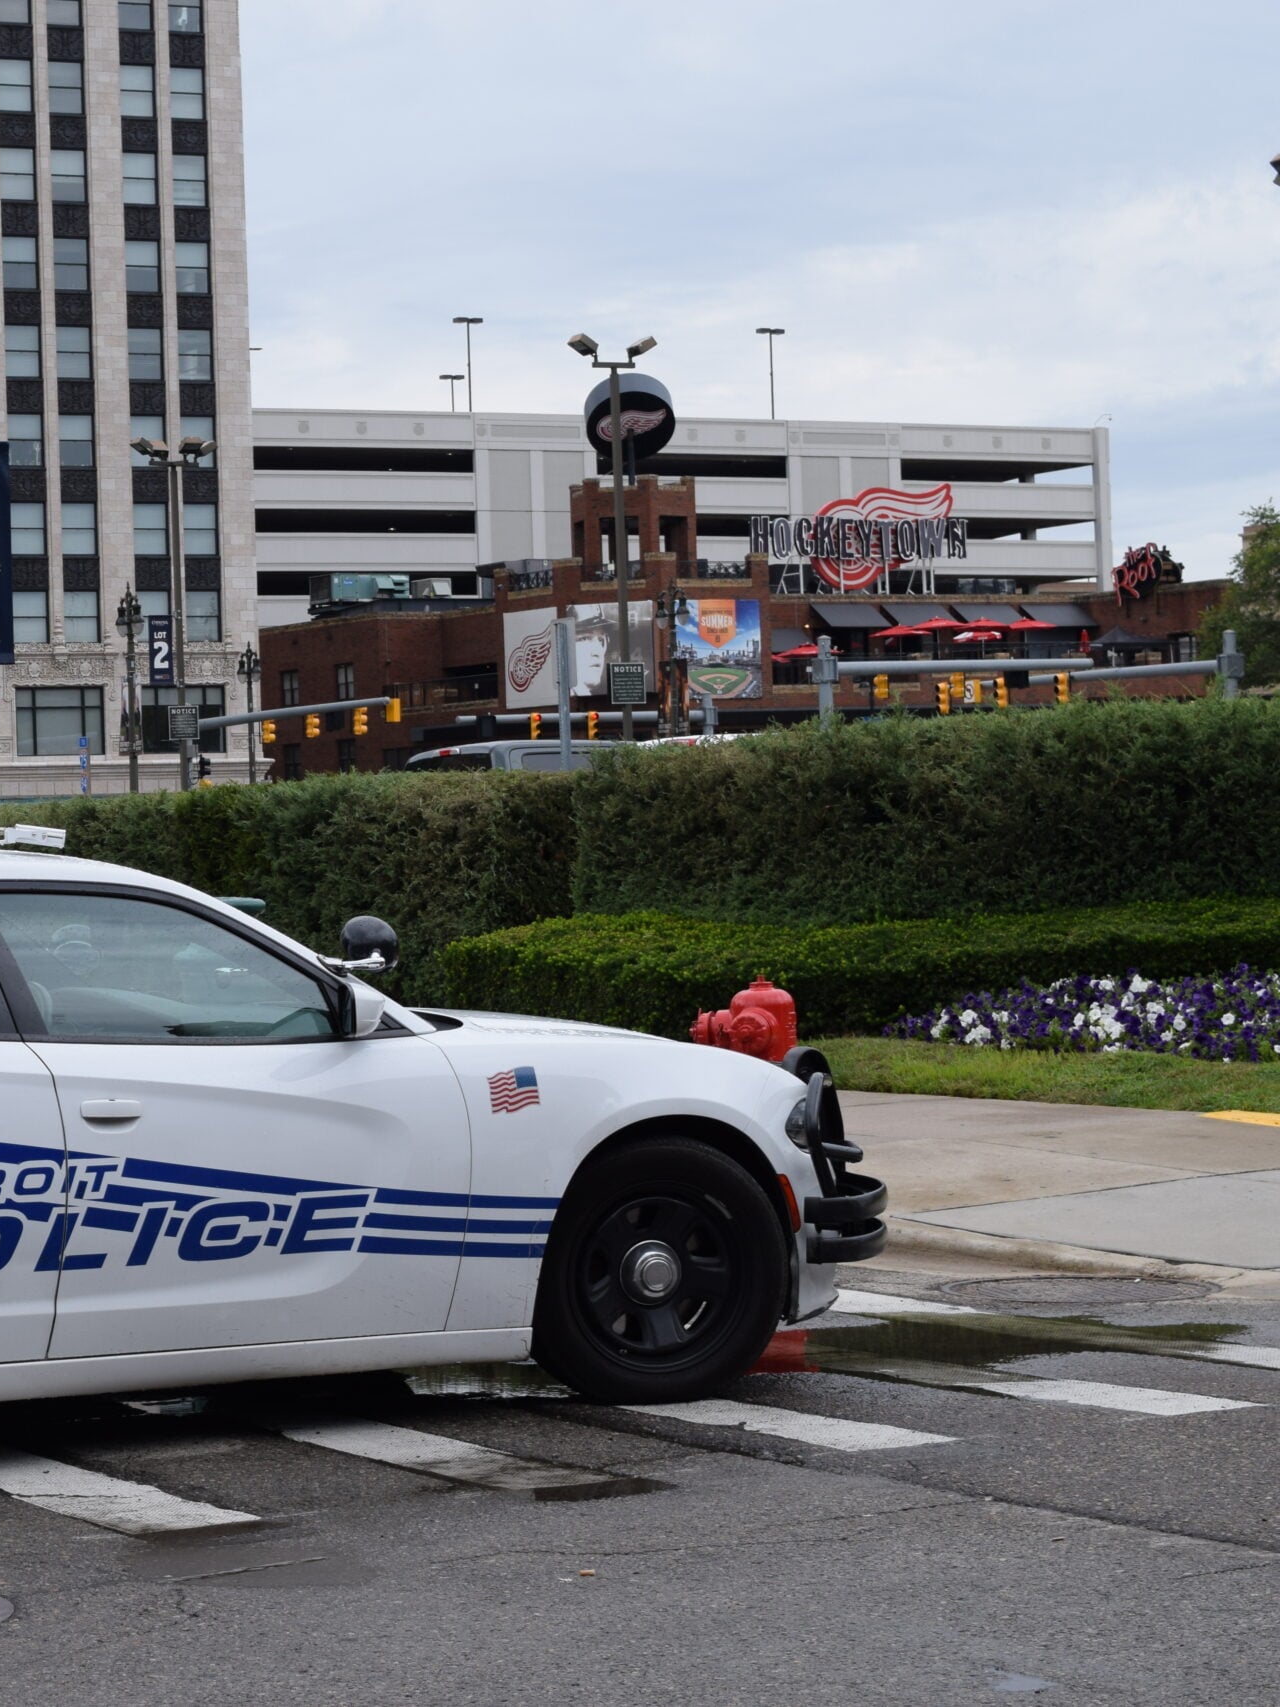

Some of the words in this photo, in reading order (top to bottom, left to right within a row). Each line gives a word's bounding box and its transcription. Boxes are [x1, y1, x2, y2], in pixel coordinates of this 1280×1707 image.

[750, 516, 968, 560] HOCKEYTOWN
[1111, 542, 1157, 607] Roof
[153, 631, 167, 639] LOT
[153, 641, 169, 668] 2
